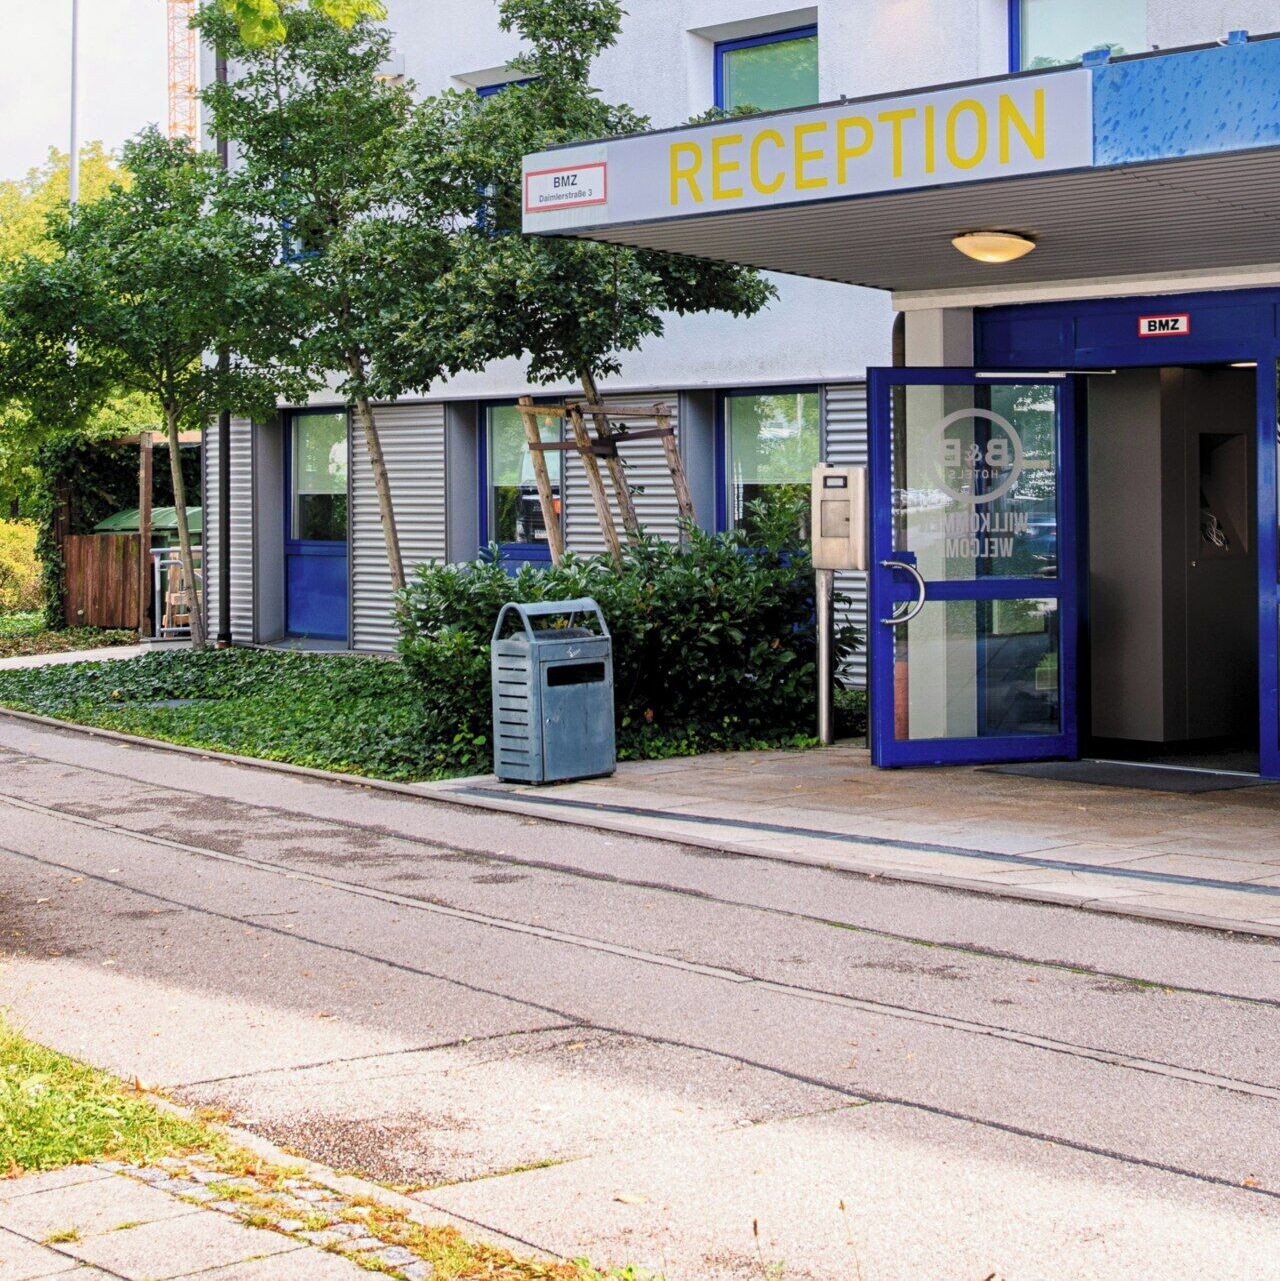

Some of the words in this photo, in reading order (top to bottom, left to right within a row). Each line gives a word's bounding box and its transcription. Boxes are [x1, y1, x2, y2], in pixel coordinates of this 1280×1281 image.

[669, 89, 1045, 205] RECEPTION
[553, 174, 578, 188] BMZ
[538, 189, 587, 203] Daimlerstraße
[587, 188, 593, 197] 3
[1147, 318, 1180, 332] BMZ
